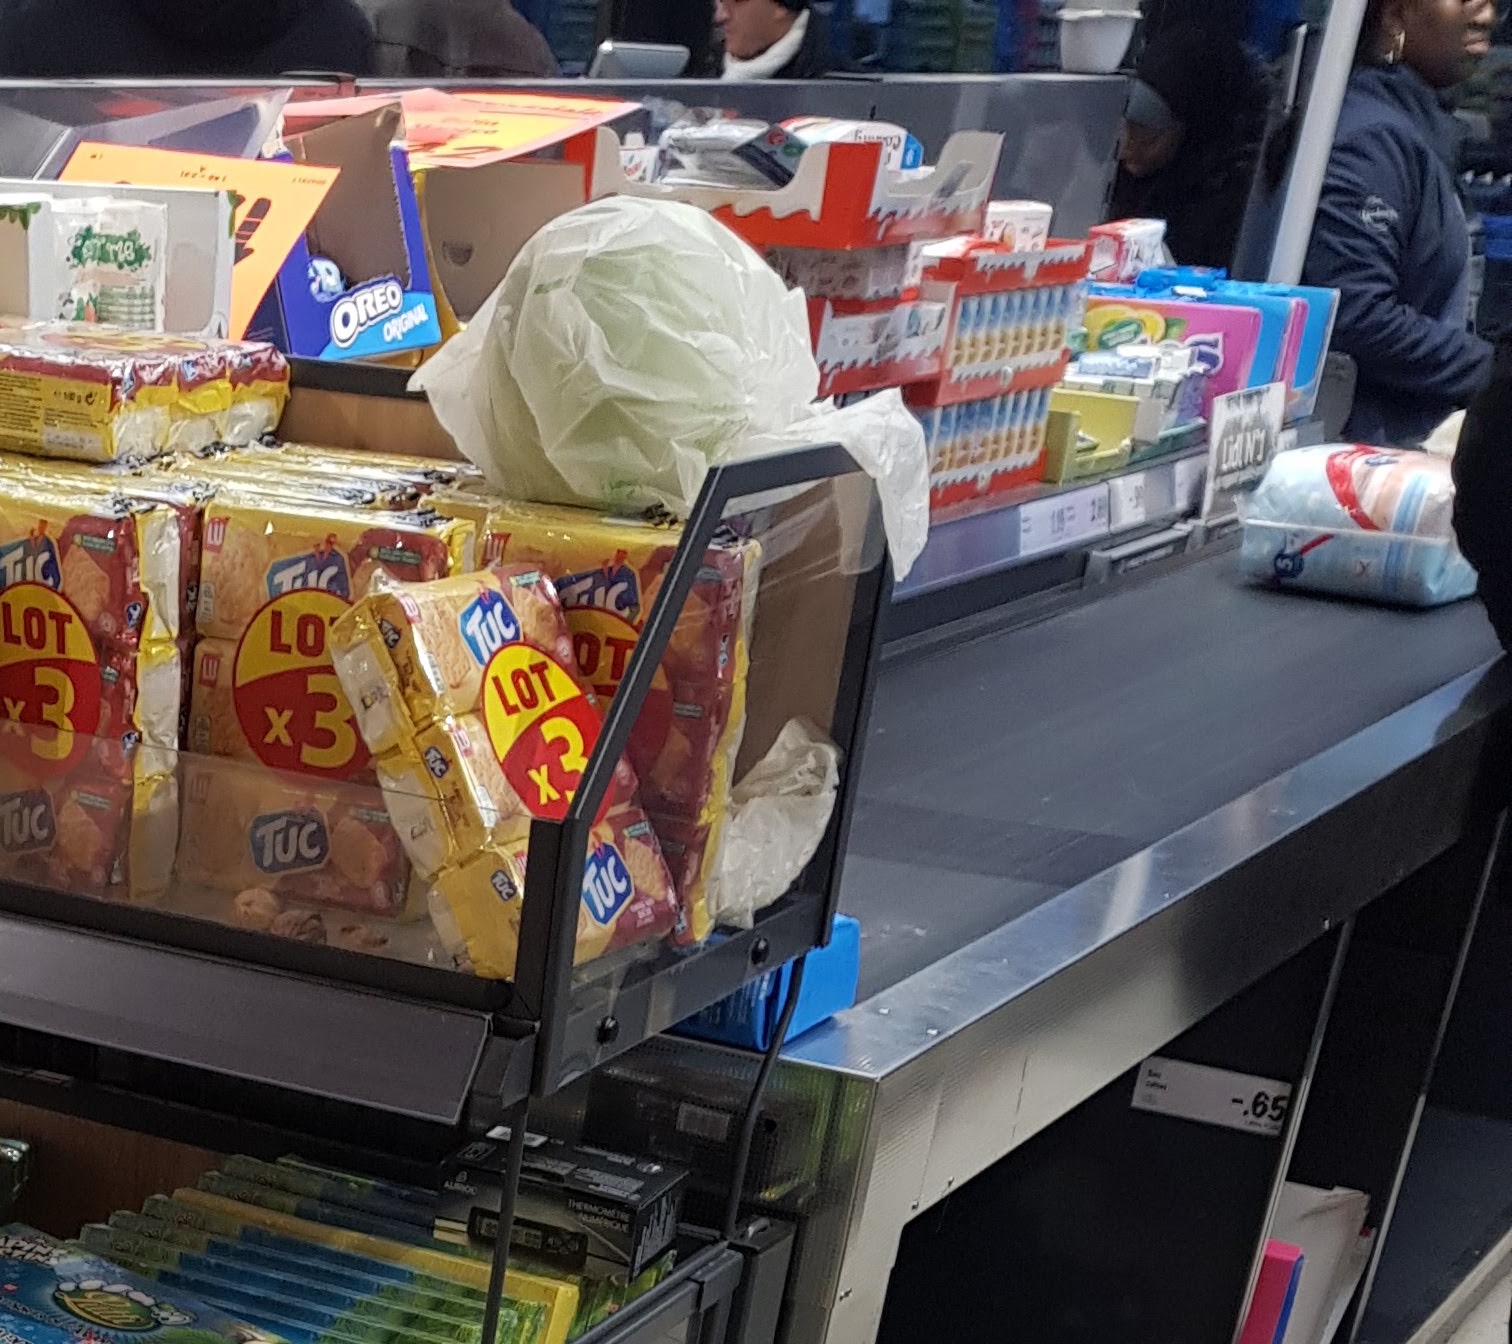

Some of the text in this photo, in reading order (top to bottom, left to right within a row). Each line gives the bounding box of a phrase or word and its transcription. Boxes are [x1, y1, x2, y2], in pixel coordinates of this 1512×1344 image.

[331, 282, 404, 347] OREO
[383, 302, 430, 343] ORIGINAL
[208, 516, 229, 548] LU
[2, 602, 73, 654] LOT
[468, 594, 519, 653] TUC
[574, 632, 635, 681] OT
[491, 660, 556, 716] LOT
[255, 822, 326, 867] TUC
[584, 855, 632, 924] TUC
